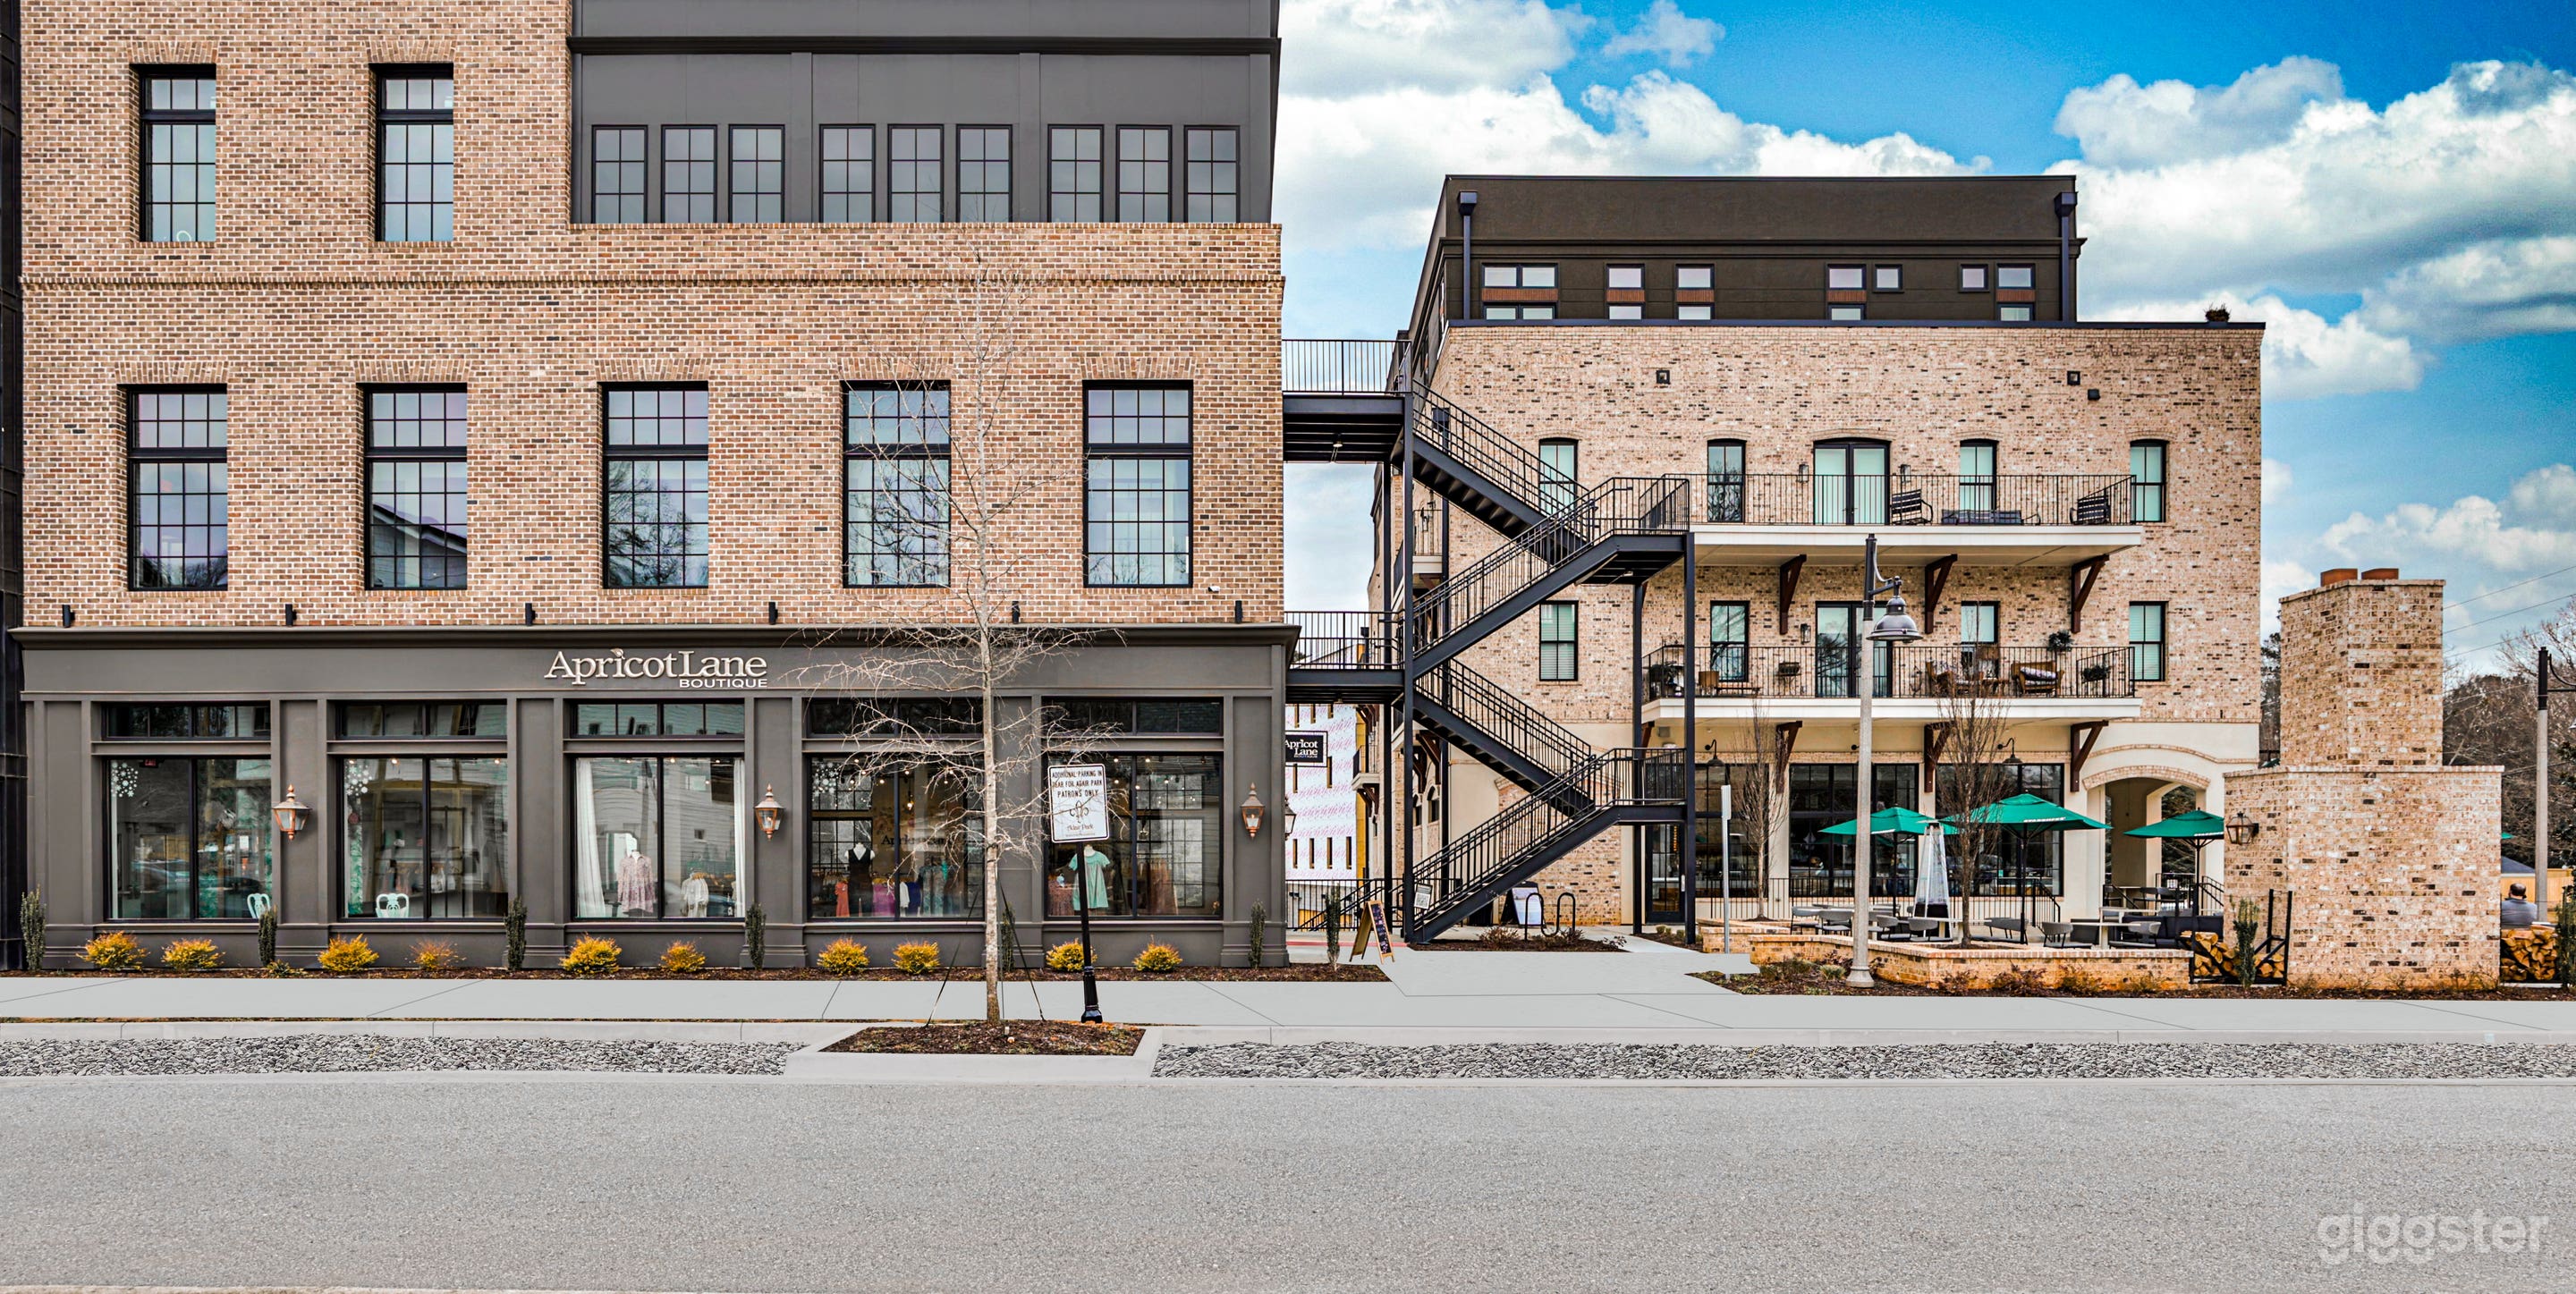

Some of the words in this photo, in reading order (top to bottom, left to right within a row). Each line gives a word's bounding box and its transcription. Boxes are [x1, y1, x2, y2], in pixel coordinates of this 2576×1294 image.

[679, 679, 768, 689] BOUTIQUE
[1284, 739, 1318, 749] Apricot
[1058, 790, 1081, 798] PATRONS
[1085, 789, 1098, 797] ONLY
